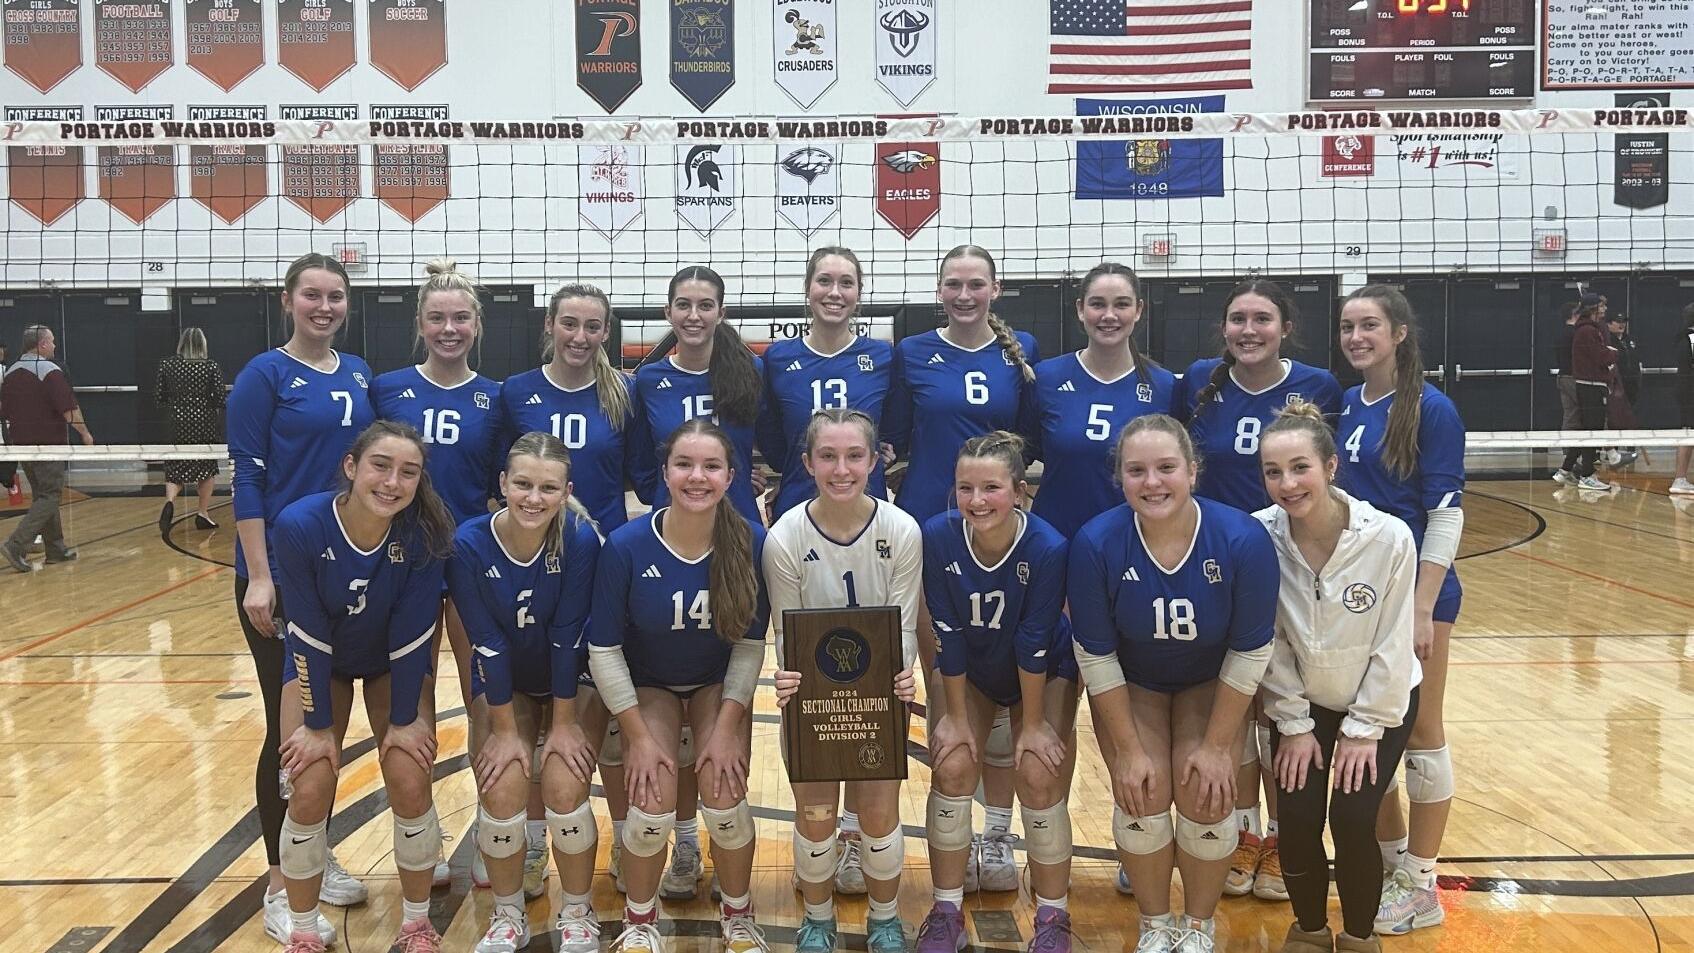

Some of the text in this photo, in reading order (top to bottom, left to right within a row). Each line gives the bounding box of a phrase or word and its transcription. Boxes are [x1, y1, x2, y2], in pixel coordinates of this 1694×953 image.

[30, 1, 52, 9] GIRLS
[305, 0, 327, 8] GIRLS
[1549, 5, 1565, 13] So,
[1670, 3, 1688, 11] this
[36, 9, 78, 22] COUNTRY
[102, 4, 164, 18] FOOTBALL
[208, 9, 239, 21] GOLF
[300, 8, 332, 21] GOLF
[385, 7, 428, 20] SOCCER
[1621, 12, 1643, 20] Rah!
[31, 24, 53, 33] 1982
[56, 24, 79, 33] 1985
[305, 22, 328, 32] 2012
[330, 22, 352, 32] 2013
[1634, 22, 1662, 30] ranks
[1667, 22, 1688, 30] with
[214, 34, 236, 43] 2004
[239, 34, 260, 43] 2007
[1548, 32, 1574, 40] None
[1578, 32, 1610, 40] better
[1614, 31, 1636, 39] east
[1656, 30, 1683, 38] west!
[1338, 38, 1366, 46] BONUS
[190, 45, 212, 54] 2013
[1434, 53, 1454, 61] FOUL
[1548, 58, 1575, 66] Carry
[1611, 57, 1649, 66] Victory!
[580, 62, 638, 73] WARRIORS
[674, 61, 731, 73] THUNDERBIRDS
[777, 60, 834, 72] CRUSADERS
[879, 64, 932, 76] VIKINGS
[1330, 89, 1355, 97] SCORE
[1408, 88, 1436, 96] MATCH
[1489, 87, 1515, 95] SCORE
[7, 109, 81, 121] CONFERENCE
[97, 108, 171, 120] CONFERENCE
[190, 107, 264, 120] CONFERENCE
[282, 107, 357, 120] CONFERENCE
[372, 107, 447, 120] CONFERENCE
[1593, 109, 1688, 126] PORTAGE
[980, 116, 1194, 135] PORTAGE WARRIORS
[1288, 111, 1501, 130] PORTAGE WARRIORS
[60, 122, 275, 139] PORTAGE WARRIORS
[369, 122, 584, 139] PORTAGE WARRIORS
[677, 121, 888, 138] PORTAGE WARRIORS
[1410, 146, 1441, 169] #1
[1445, 150, 1470, 160] with
[1474, 148, 1495, 161] us!
[1324, 163, 1372, 171] CONFERENCE
[1130, 182, 1169, 195] 1848
[586, 192, 635, 203] VIKINGS
[781, 195, 834, 206] BEAVERS
[886, 189, 931, 201] EAGLES
[677, 197, 733, 206] SPARTANS
[1544, 235, 1562, 249] EXIT
[1346, 246, 1361, 256] 29
[148, 262, 163, 272] 28
[964, 371, 989, 405] 6
[811, 378, 848, 415] 13
[330, 391, 353, 427] 7
[422, 408, 461, 445] 16
[1085, 403, 1114, 441] 5
[550, 413, 587, 449] 10
[1234, 416, 1262, 455] 8
[1345, 425, 1366, 463] 4
[842, 570, 861, 608] 1
[347, 578, 369, 616] 3
[516, 589, 536, 629] 2
[671, 589, 712, 631] 14
[969, 590, 1006, 630] 17
[1152, 597, 1198, 641] 18
[832, 690, 858, 698] 2024
[802, 697, 889, 714] SECTIONAL CHAMPION
[829, 714, 862, 723] GIRLS
[812, 722, 880, 732] VOLLEYBALL
[818, 731, 876, 741] DIVISION 2
